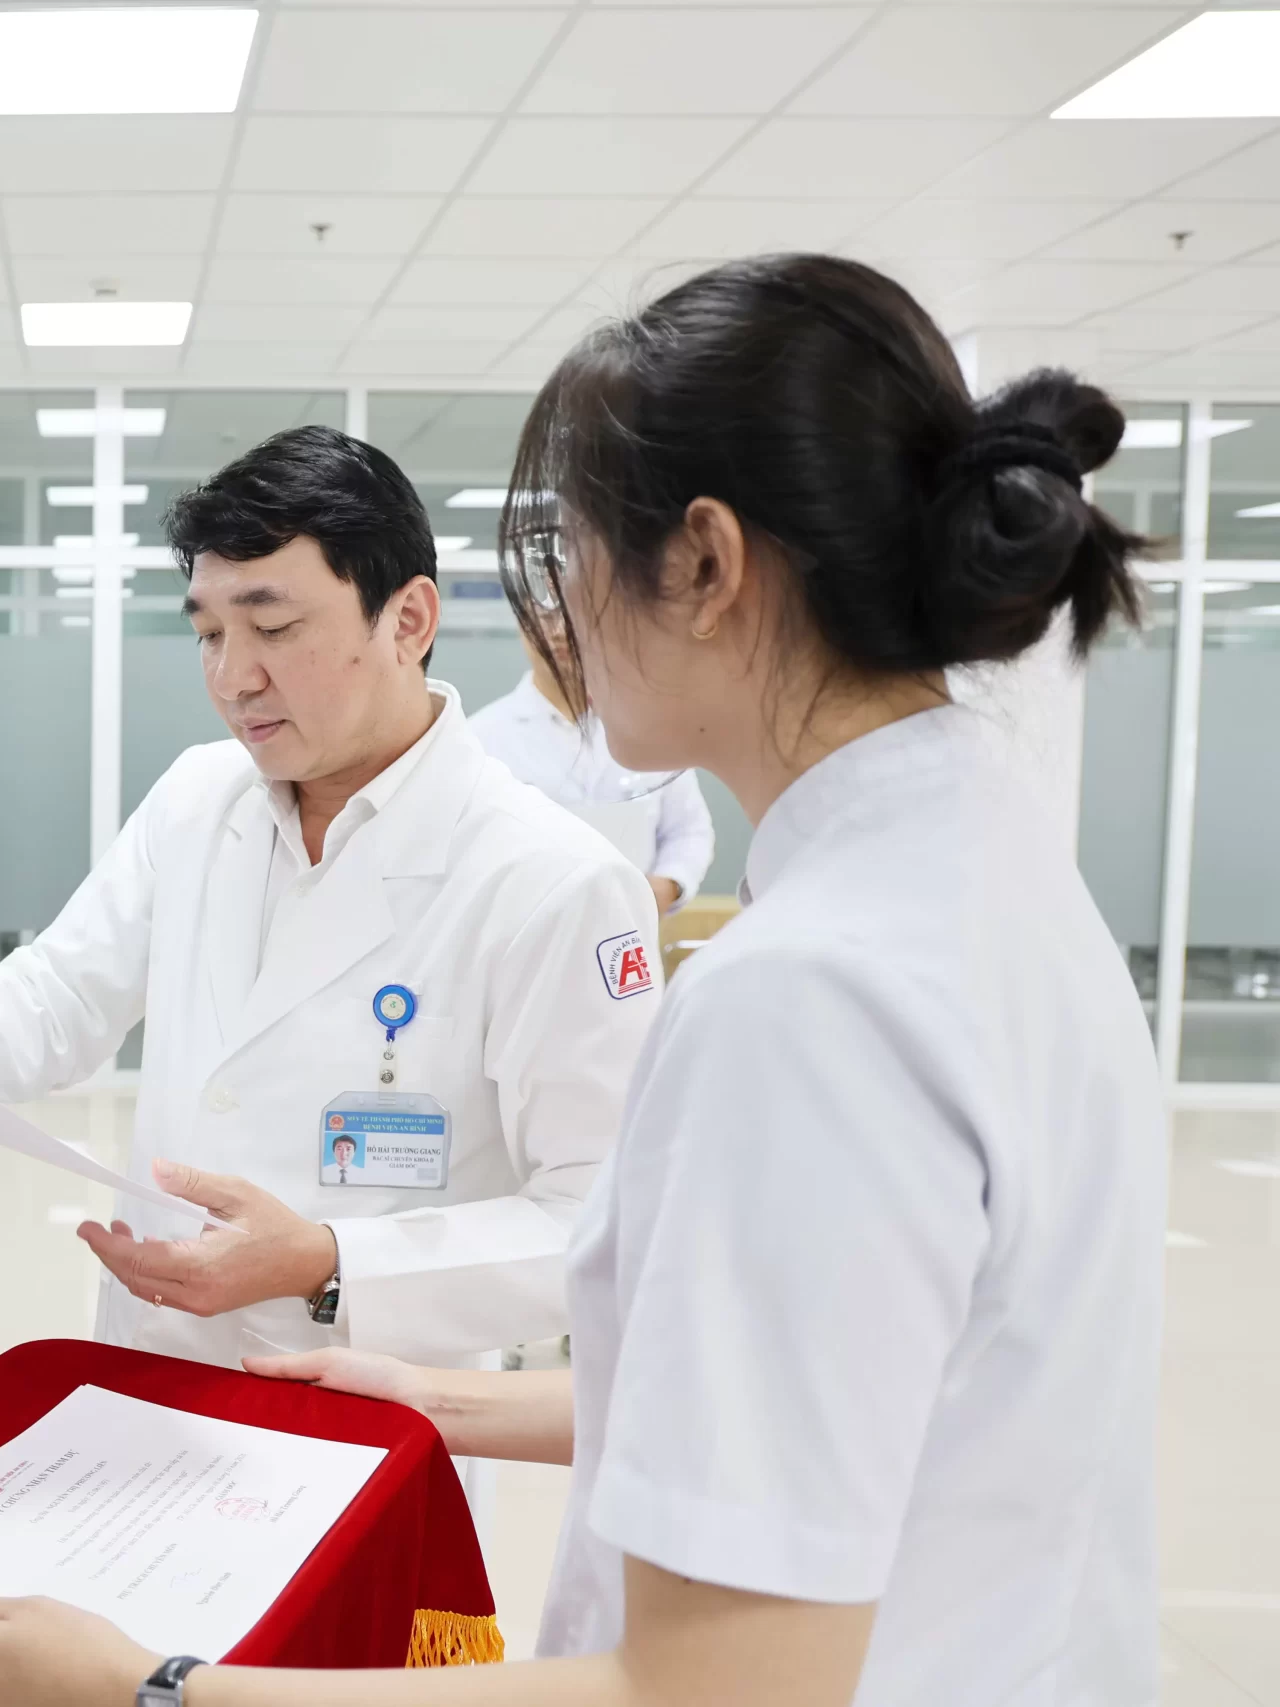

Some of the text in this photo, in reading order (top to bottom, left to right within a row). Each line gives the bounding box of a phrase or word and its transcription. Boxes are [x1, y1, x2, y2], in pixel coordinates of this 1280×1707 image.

[621, 940, 630, 948] AN
[390, 1146, 419, 1155] TRƯỜNG
[1, 1487, 30, 1509] CHỨNG
[25, 1473, 48, 1488] NHẬN
[45, 1457, 68, 1473] THAM
[64, 1449, 80, 1459] DỰ
